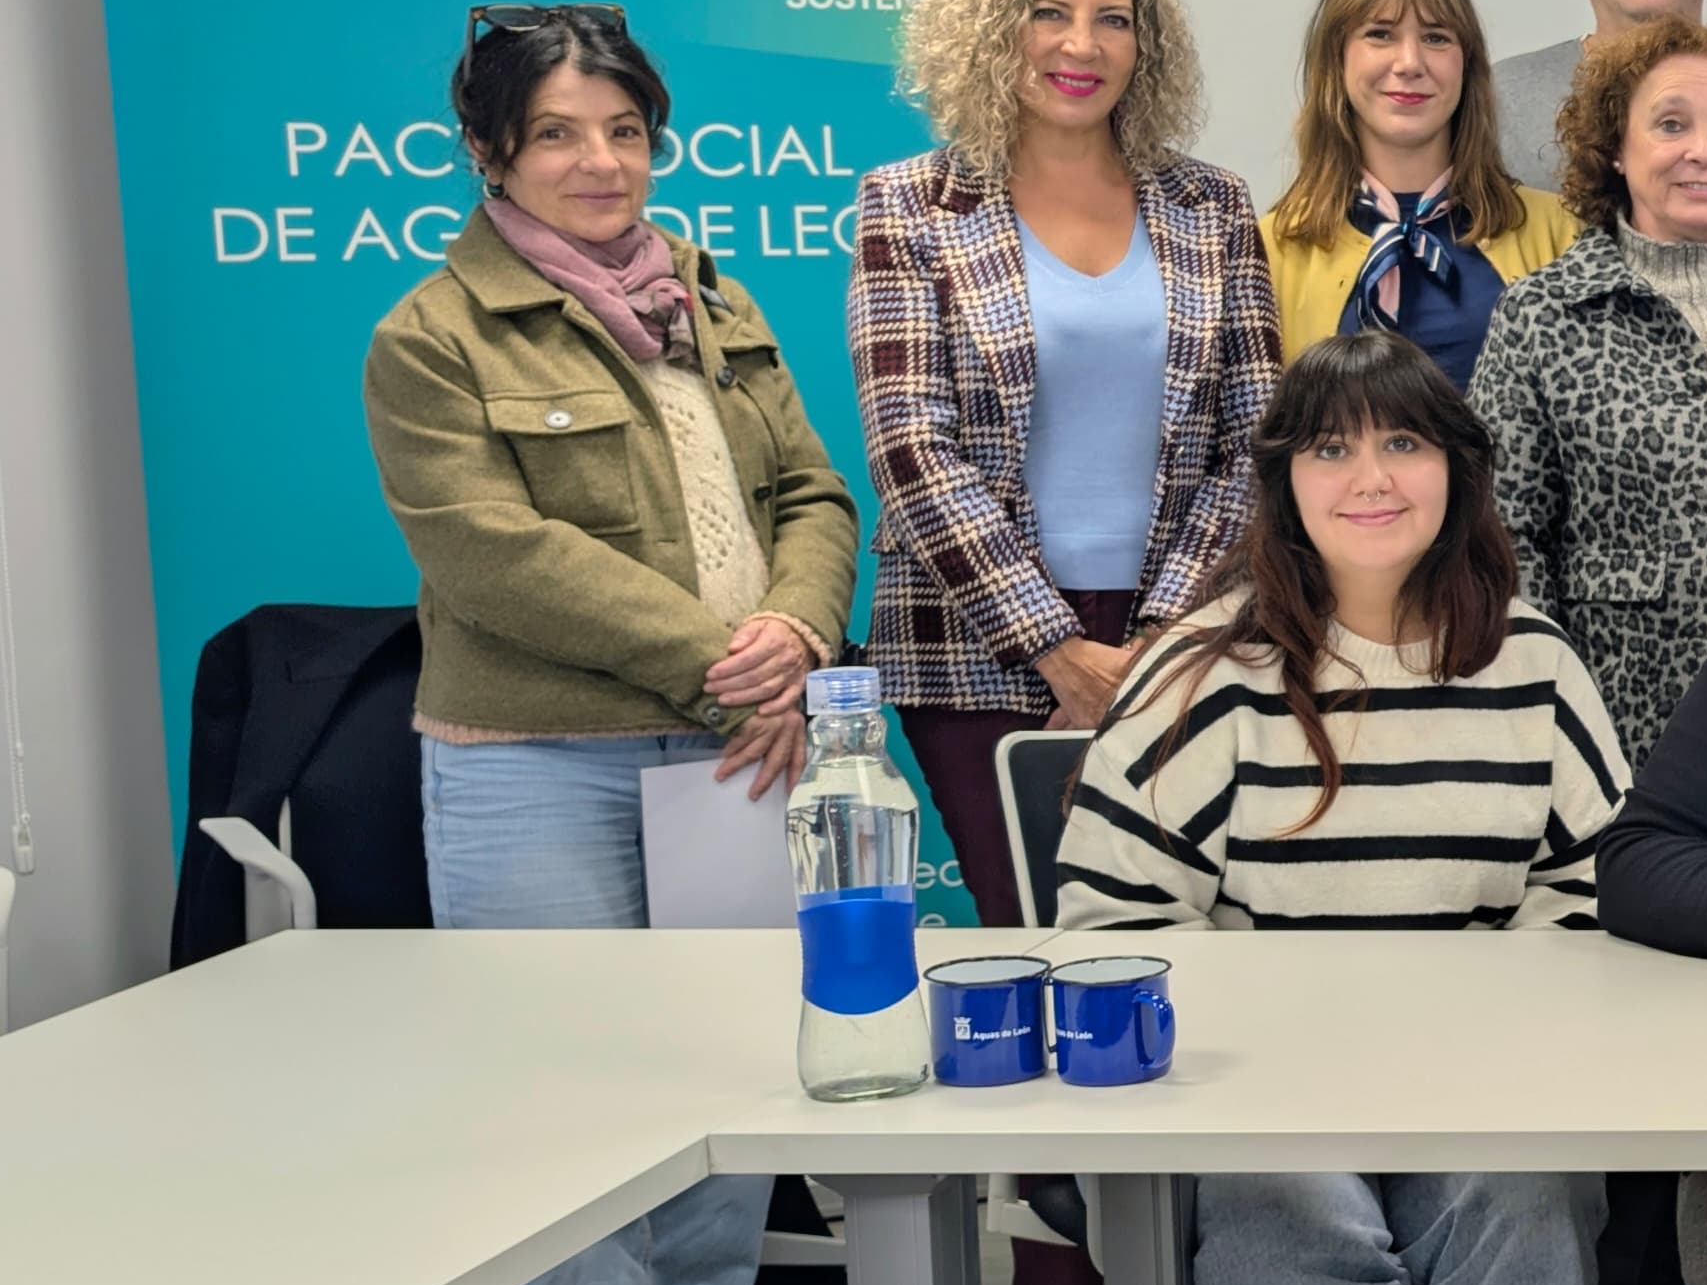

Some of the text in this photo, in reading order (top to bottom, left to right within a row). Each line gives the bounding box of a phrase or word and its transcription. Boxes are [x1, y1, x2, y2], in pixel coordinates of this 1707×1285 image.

[285, 120, 462, 178] PAC
[212, 206, 317, 263] DE
[973, 1026, 1031, 1042] Aguas de León
[1075, 1030, 1093, 1040] León
